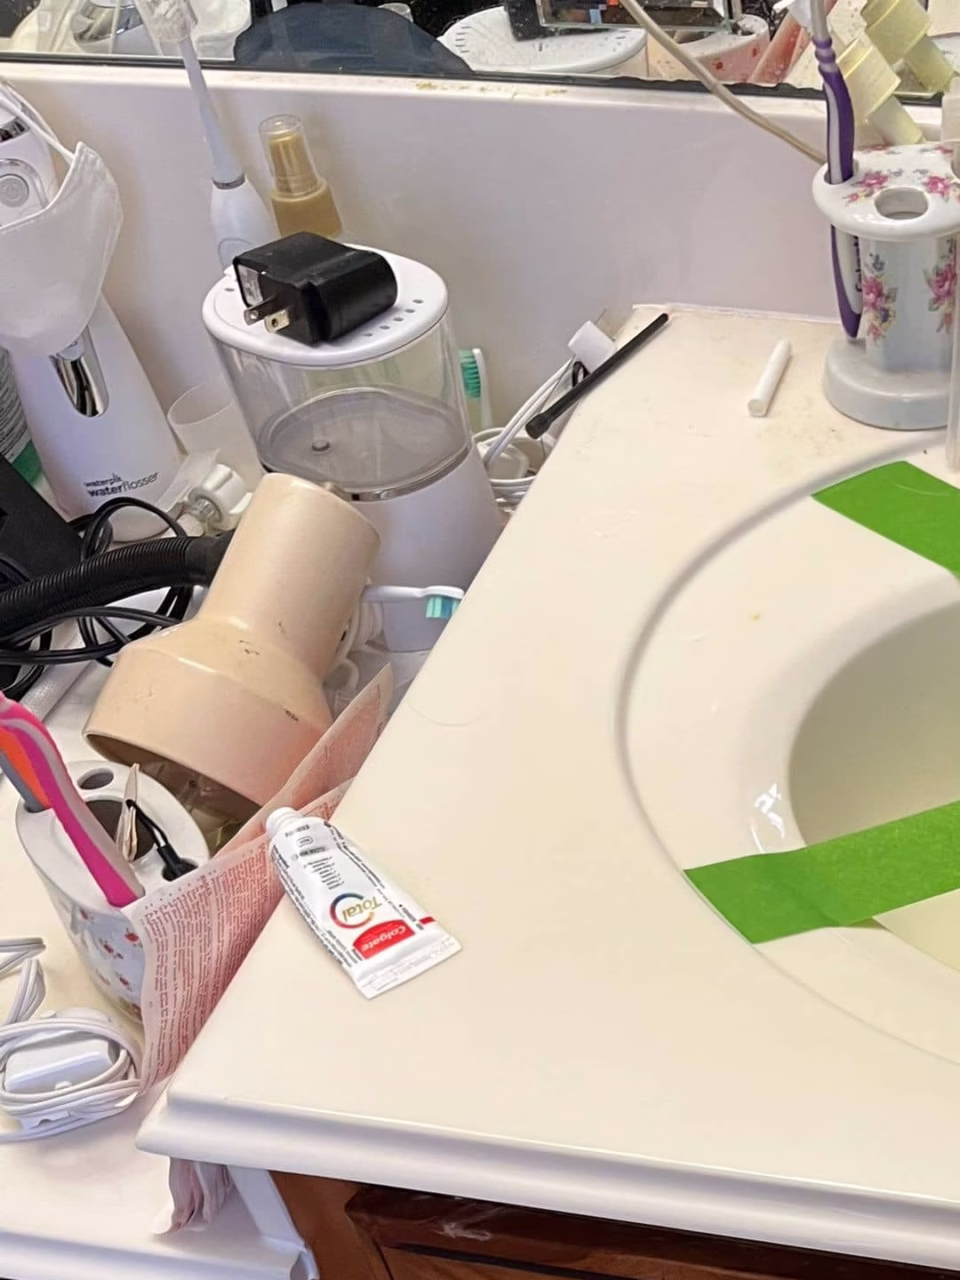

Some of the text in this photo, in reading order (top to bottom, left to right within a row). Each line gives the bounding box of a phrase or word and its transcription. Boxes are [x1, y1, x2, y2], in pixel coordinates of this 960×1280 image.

[87, 472, 158, 497] waterflosser
[342, 896, 382, 922] Total
[361, 925, 407, 951] Colgate
